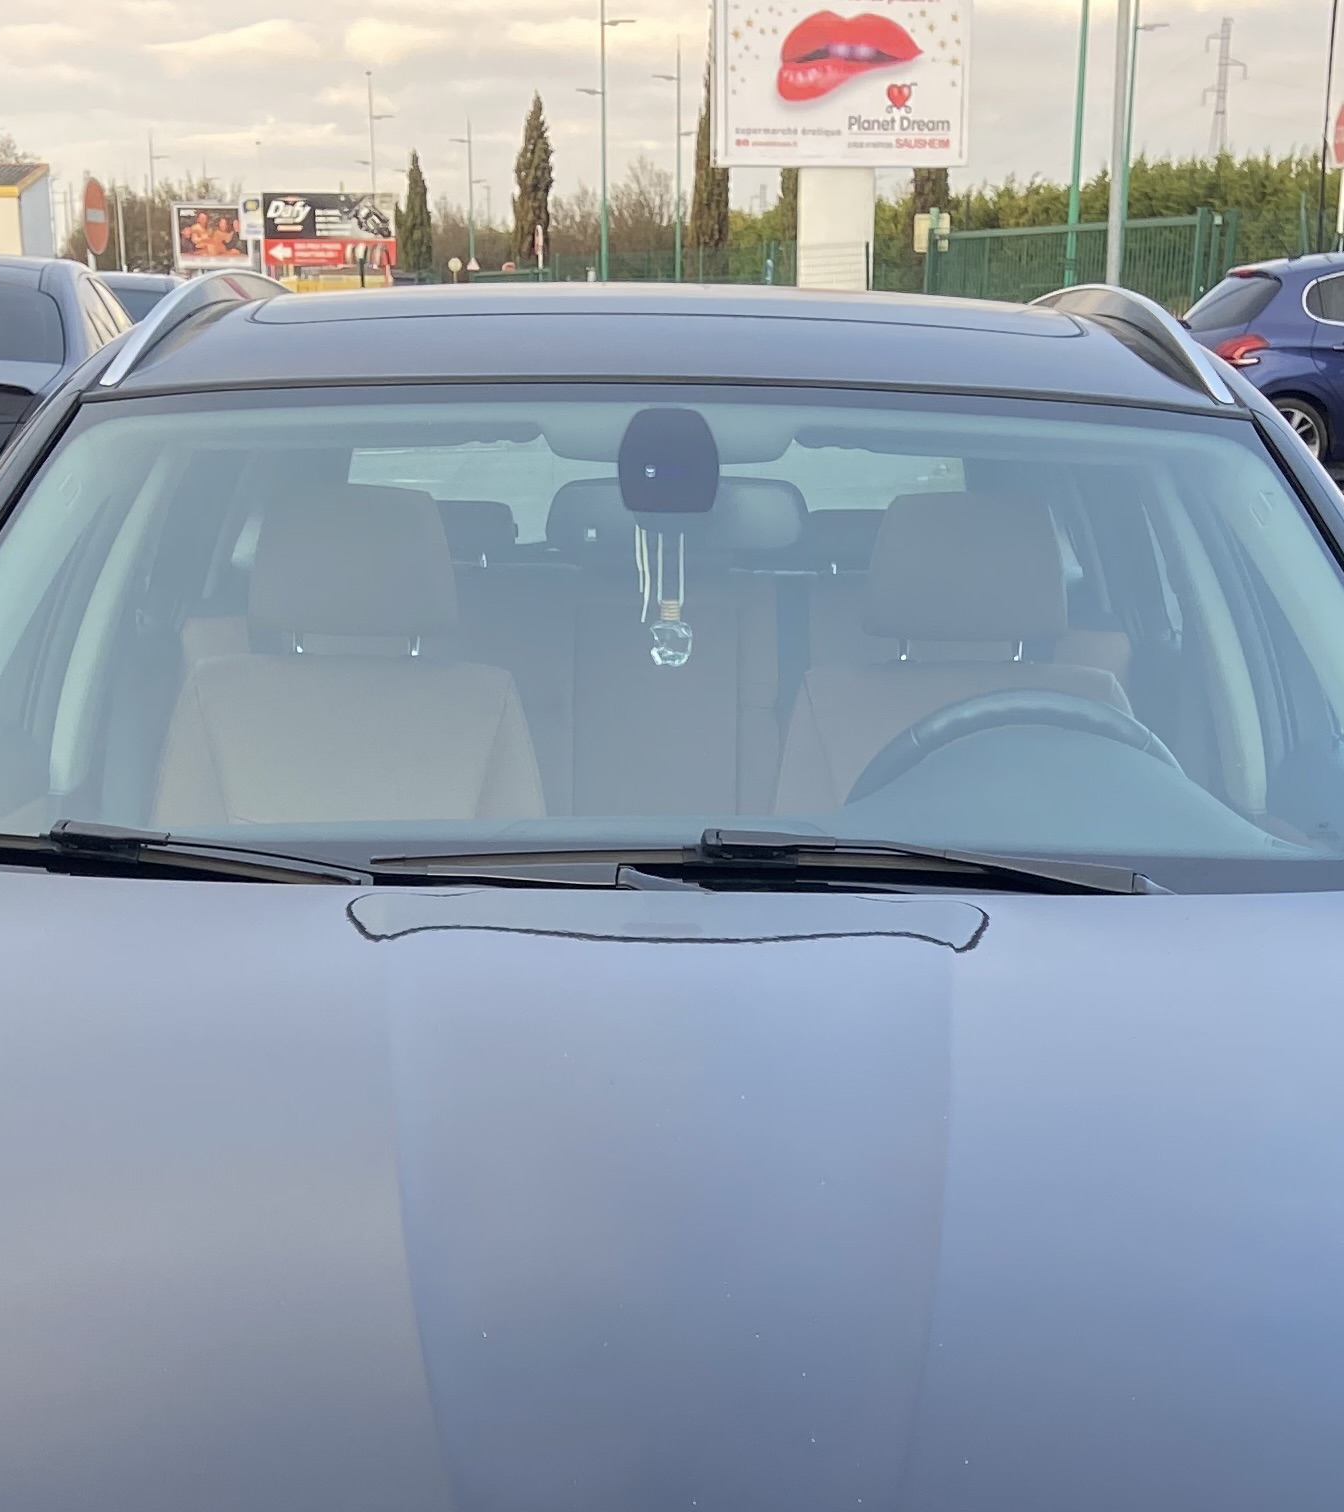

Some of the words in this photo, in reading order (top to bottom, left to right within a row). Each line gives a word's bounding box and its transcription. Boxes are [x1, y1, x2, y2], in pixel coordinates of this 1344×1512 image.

[847, 114, 896, 132] Planet
[899, 115, 952, 132] Dream
[266, 199, 311, 223] Dafy
